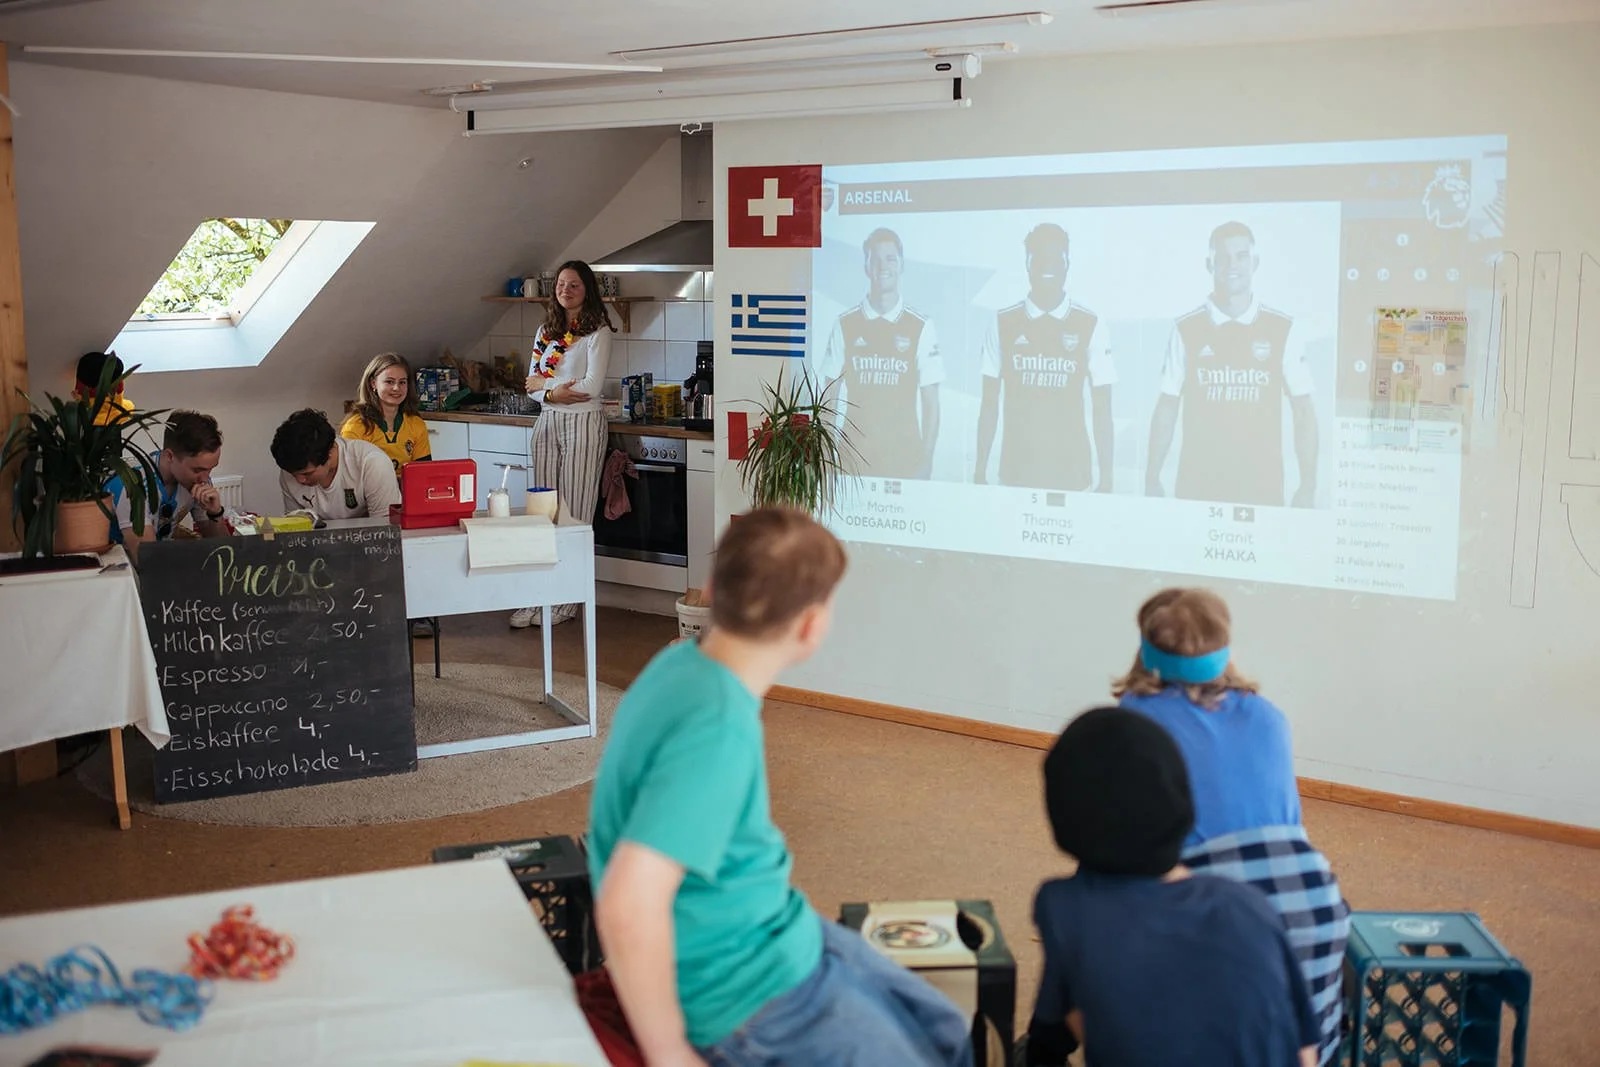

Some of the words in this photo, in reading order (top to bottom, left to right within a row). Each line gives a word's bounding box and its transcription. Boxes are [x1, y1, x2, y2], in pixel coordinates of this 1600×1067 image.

[844, 189, 913, 205] ARSENAL
[852, 354, 908, 373] Emirates
[1013, 354, 1077, 374] Emirates
[1197, 365, 1270, 386] Emirates
[867, 501, 905, 514] Martin
[1208, 506, 1223, 518] 34
[846, 515, 907, 530] ODEGAARD
[910, 519, 926, 534] (C)
[1022, 513, 1073, 529] Thomas
[1022, 530, 1074, 546] PARTEY
[1208, 529, 1255, 545] Granit
[1204, 546, 1257, 563] XHAKA
[202, 545, 334, 597] Preise
[161, 599, 226, 625] Kaffee
[164, 620, 291, 654] Milchkaffee
[164, 664, 267, 695] Espresso
[167, 697, 288, 729] Cappuccino
[170, 721, 281, 751] Eiskaffee
[171, 749, 340, 791] Eisschokolade
